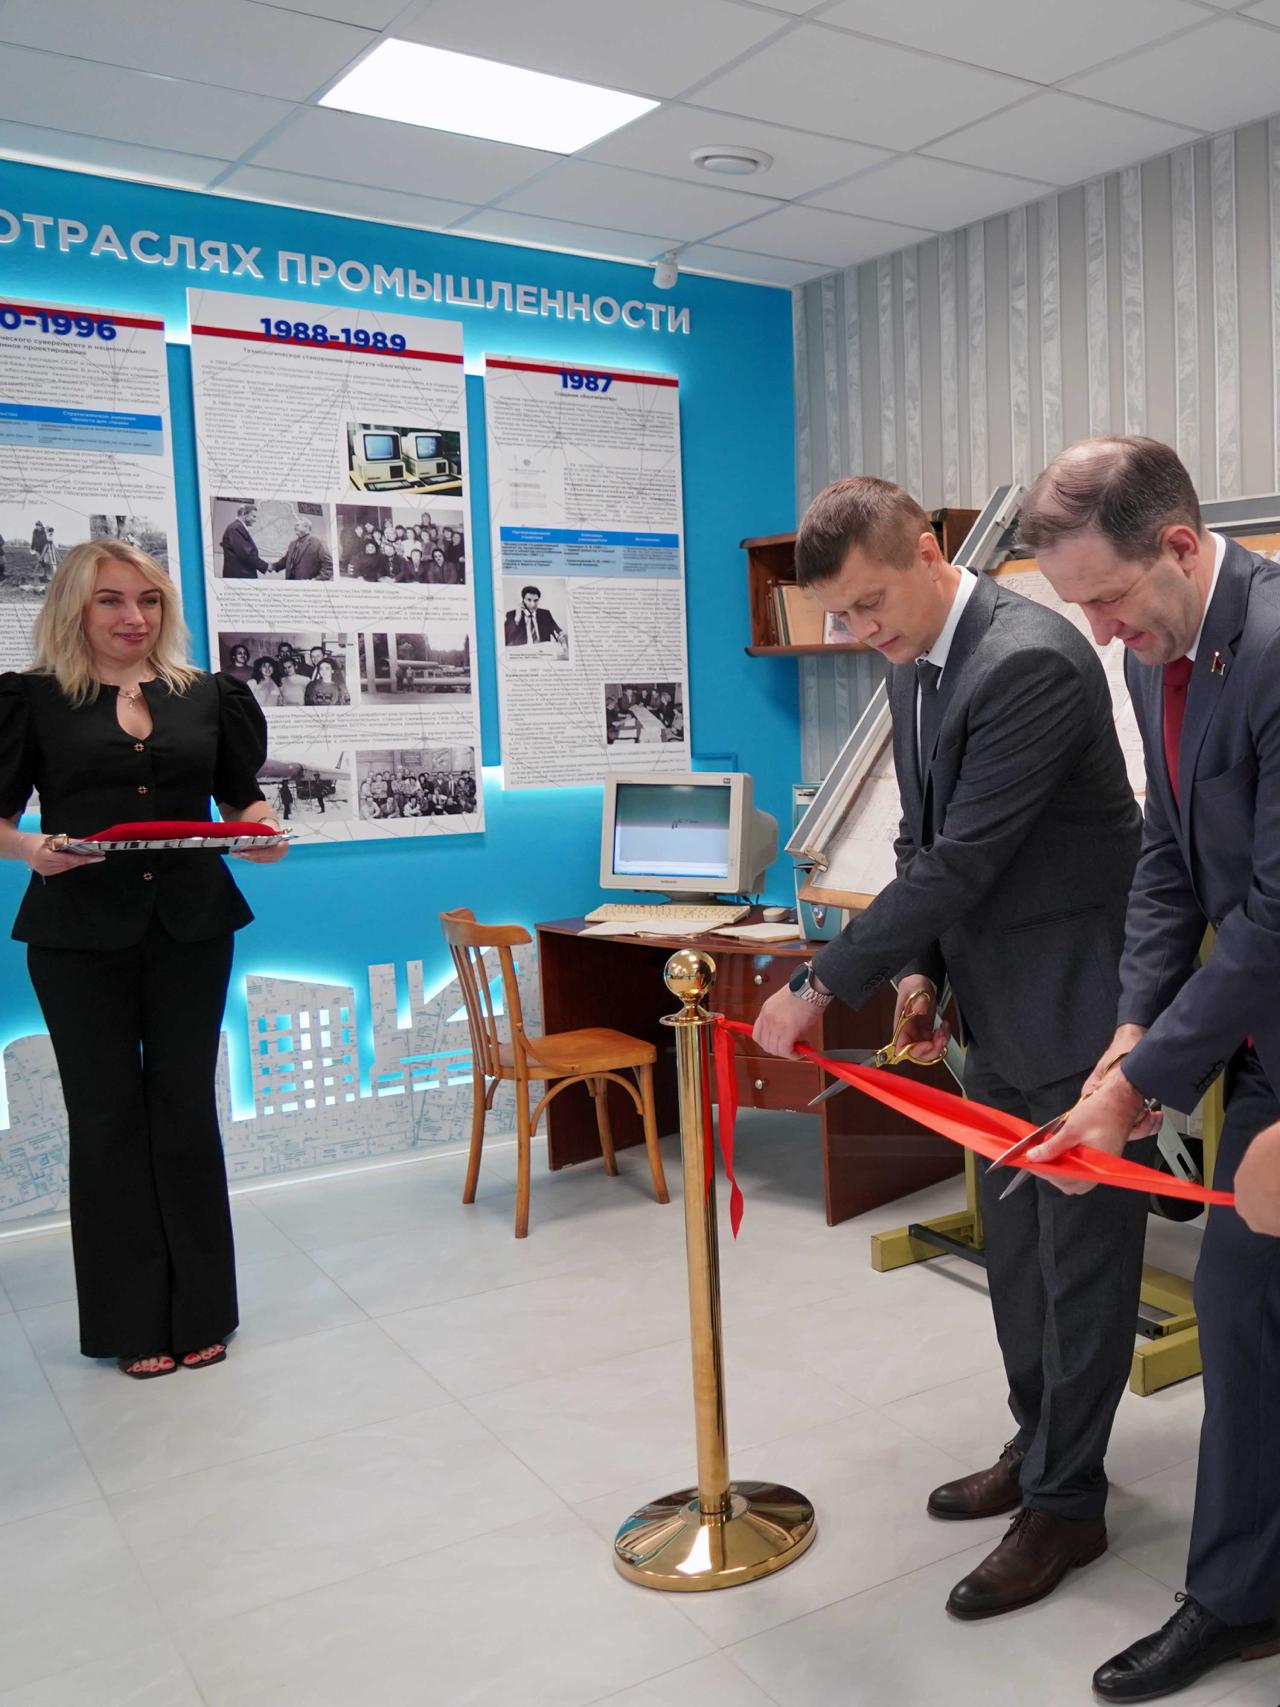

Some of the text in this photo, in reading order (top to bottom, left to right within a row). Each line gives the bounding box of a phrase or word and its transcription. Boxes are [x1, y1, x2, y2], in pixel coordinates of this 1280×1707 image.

[0, 209, 692, 335] ОТРАСЛЯХ ПРОМЫШЛЕННОСТИ
[260, 318, 406, 352] 1988-1989
[559, 370, 614, 392] 1987
